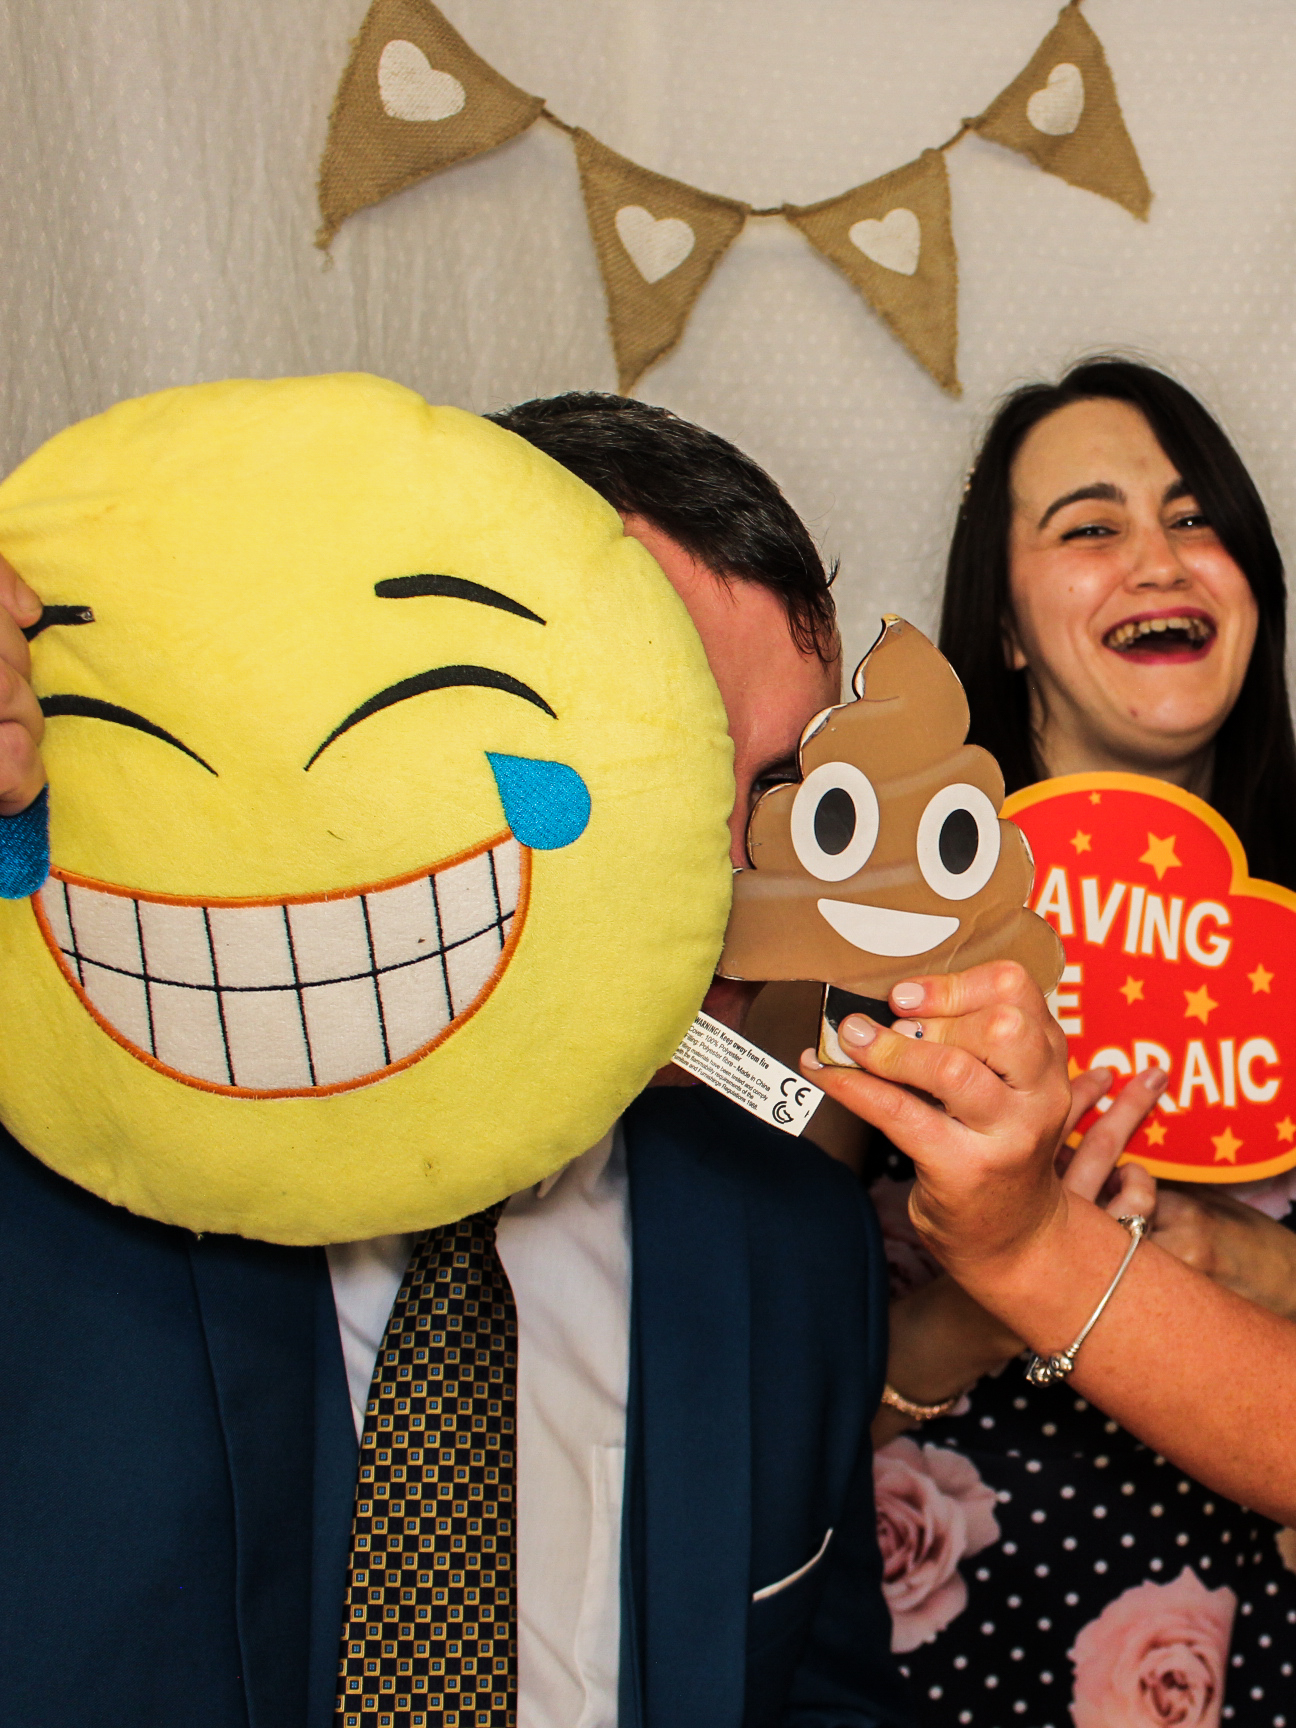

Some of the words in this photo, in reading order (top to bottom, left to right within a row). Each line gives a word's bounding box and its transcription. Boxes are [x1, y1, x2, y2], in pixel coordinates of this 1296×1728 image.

[1033, 866, 1232, 968] AVING
[688, 1025, 704, 1037] Cover:
[706, 1035, 718, 1047] 100%
[719, 1044, 742, 1061] Polyester
[694, 1016, 721, 1036] WARNING!
[720, 1032, 733, 1045] Keep
[733, 1042, 747, 1055] away
[746, 1049, 760, 1063] from
[759, 1058, 769, 1069] fire
[699, 1042, 722, 1059] Polyester
[722, 1056, 733, 1067] fibre
[737, 1065, 750, 1078] Made
[756, 1079, 770, 1091] China
[683, 1051, 691, 1059] the
[691, 1056, 714, 1074] flammability
[715, 1072, 742, 1091] requirements
[691, 1049, 709, 1062] materials
[710, 1060, 720, 1069] have
[720, 1067, 731, 1076] been
[731, 1074, 745, 1085] tested
[744, 1083, 753, 1091] and
[753, 1089, 768, 1101] comply
[698, 1068, 721, 1086] Furnishings
[721, 1084, 746, 1102] Regulations
